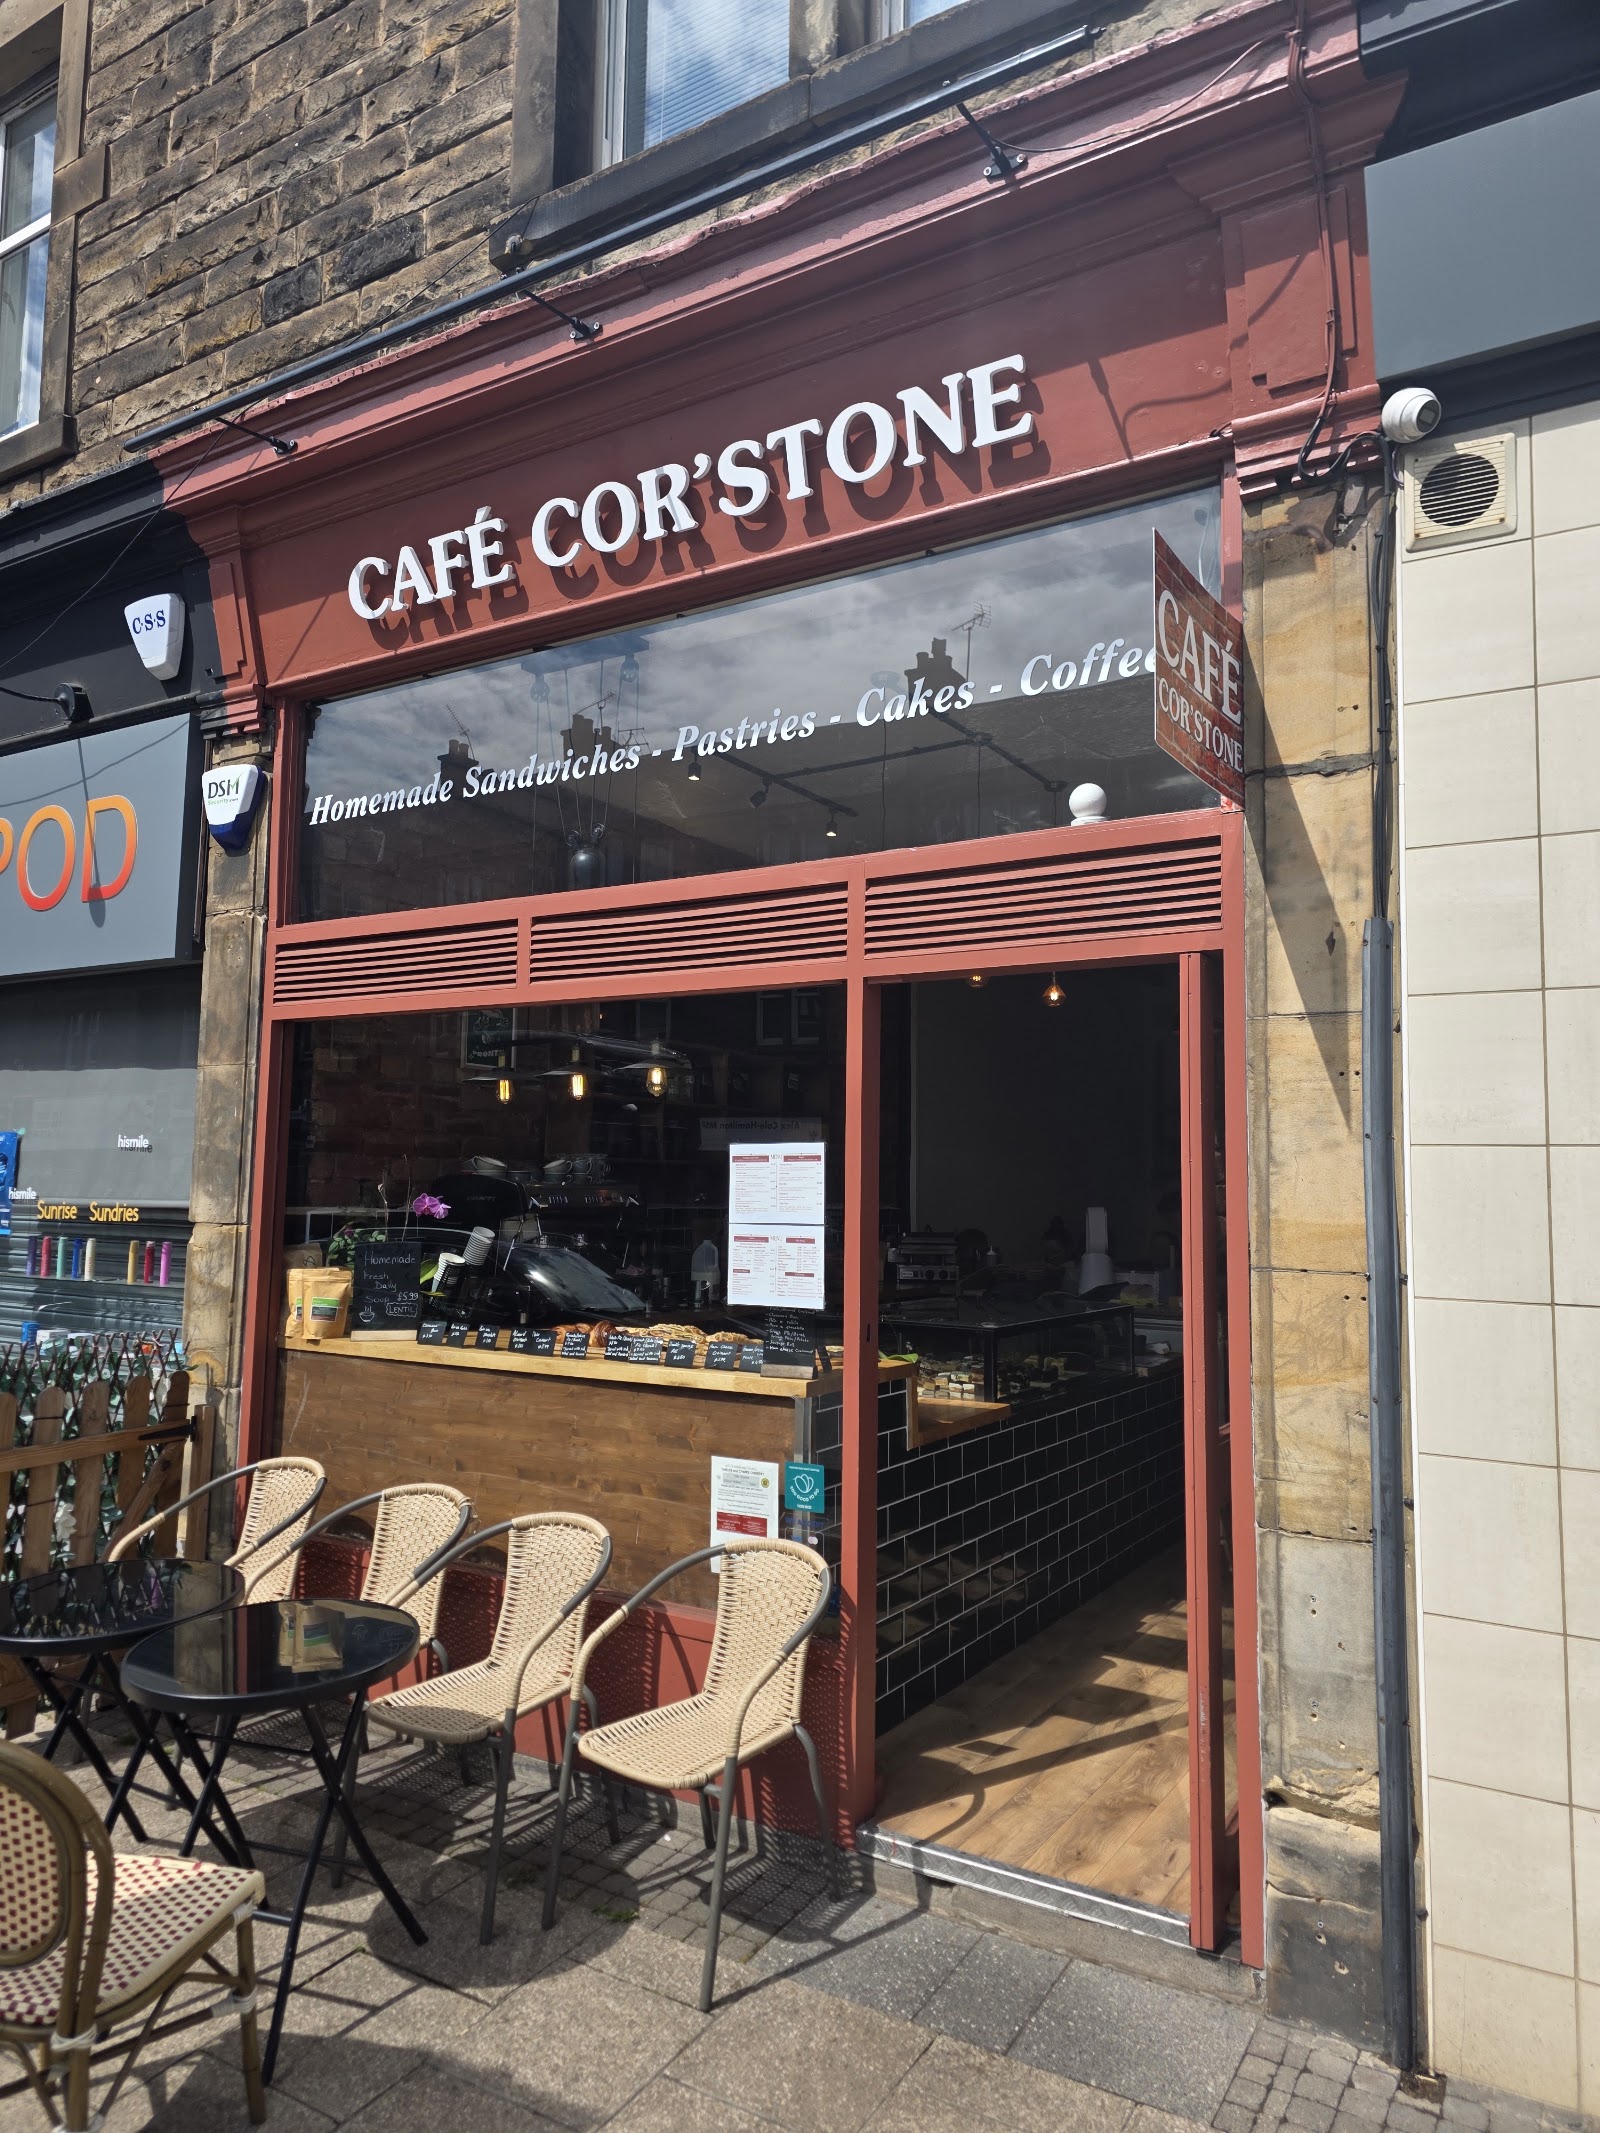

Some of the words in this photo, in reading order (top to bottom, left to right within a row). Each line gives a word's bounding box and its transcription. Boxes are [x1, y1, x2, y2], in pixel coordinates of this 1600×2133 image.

[348, 506, 516, 620] CAFÉ
[531, 354, 1034, 567] COR'STONE
[1158, 590, 1241, 725] CAFÉ
[1158, 677, 1243, 774] COR'STONE
[309, 772, 454, 826] Homemade
[462, 743, 642, 799] Sandwiches
[671, 708, 818, 762] Pastries
[856, 677, 976, 728] Cakes
[0, 795, 138, 911] OD
[117, 1135, 149, 1148] hismile
[8, 1187, 37, 1200] hismile
[36, 1200, 78, 1220] Sunrise
[89, 1201, 139, 1222] Sundries
[364, 1250, 417, 1266] Homemade
[373, 1281, 397, 1293] Daily
[364, 1295, 390, 1306] Soup
